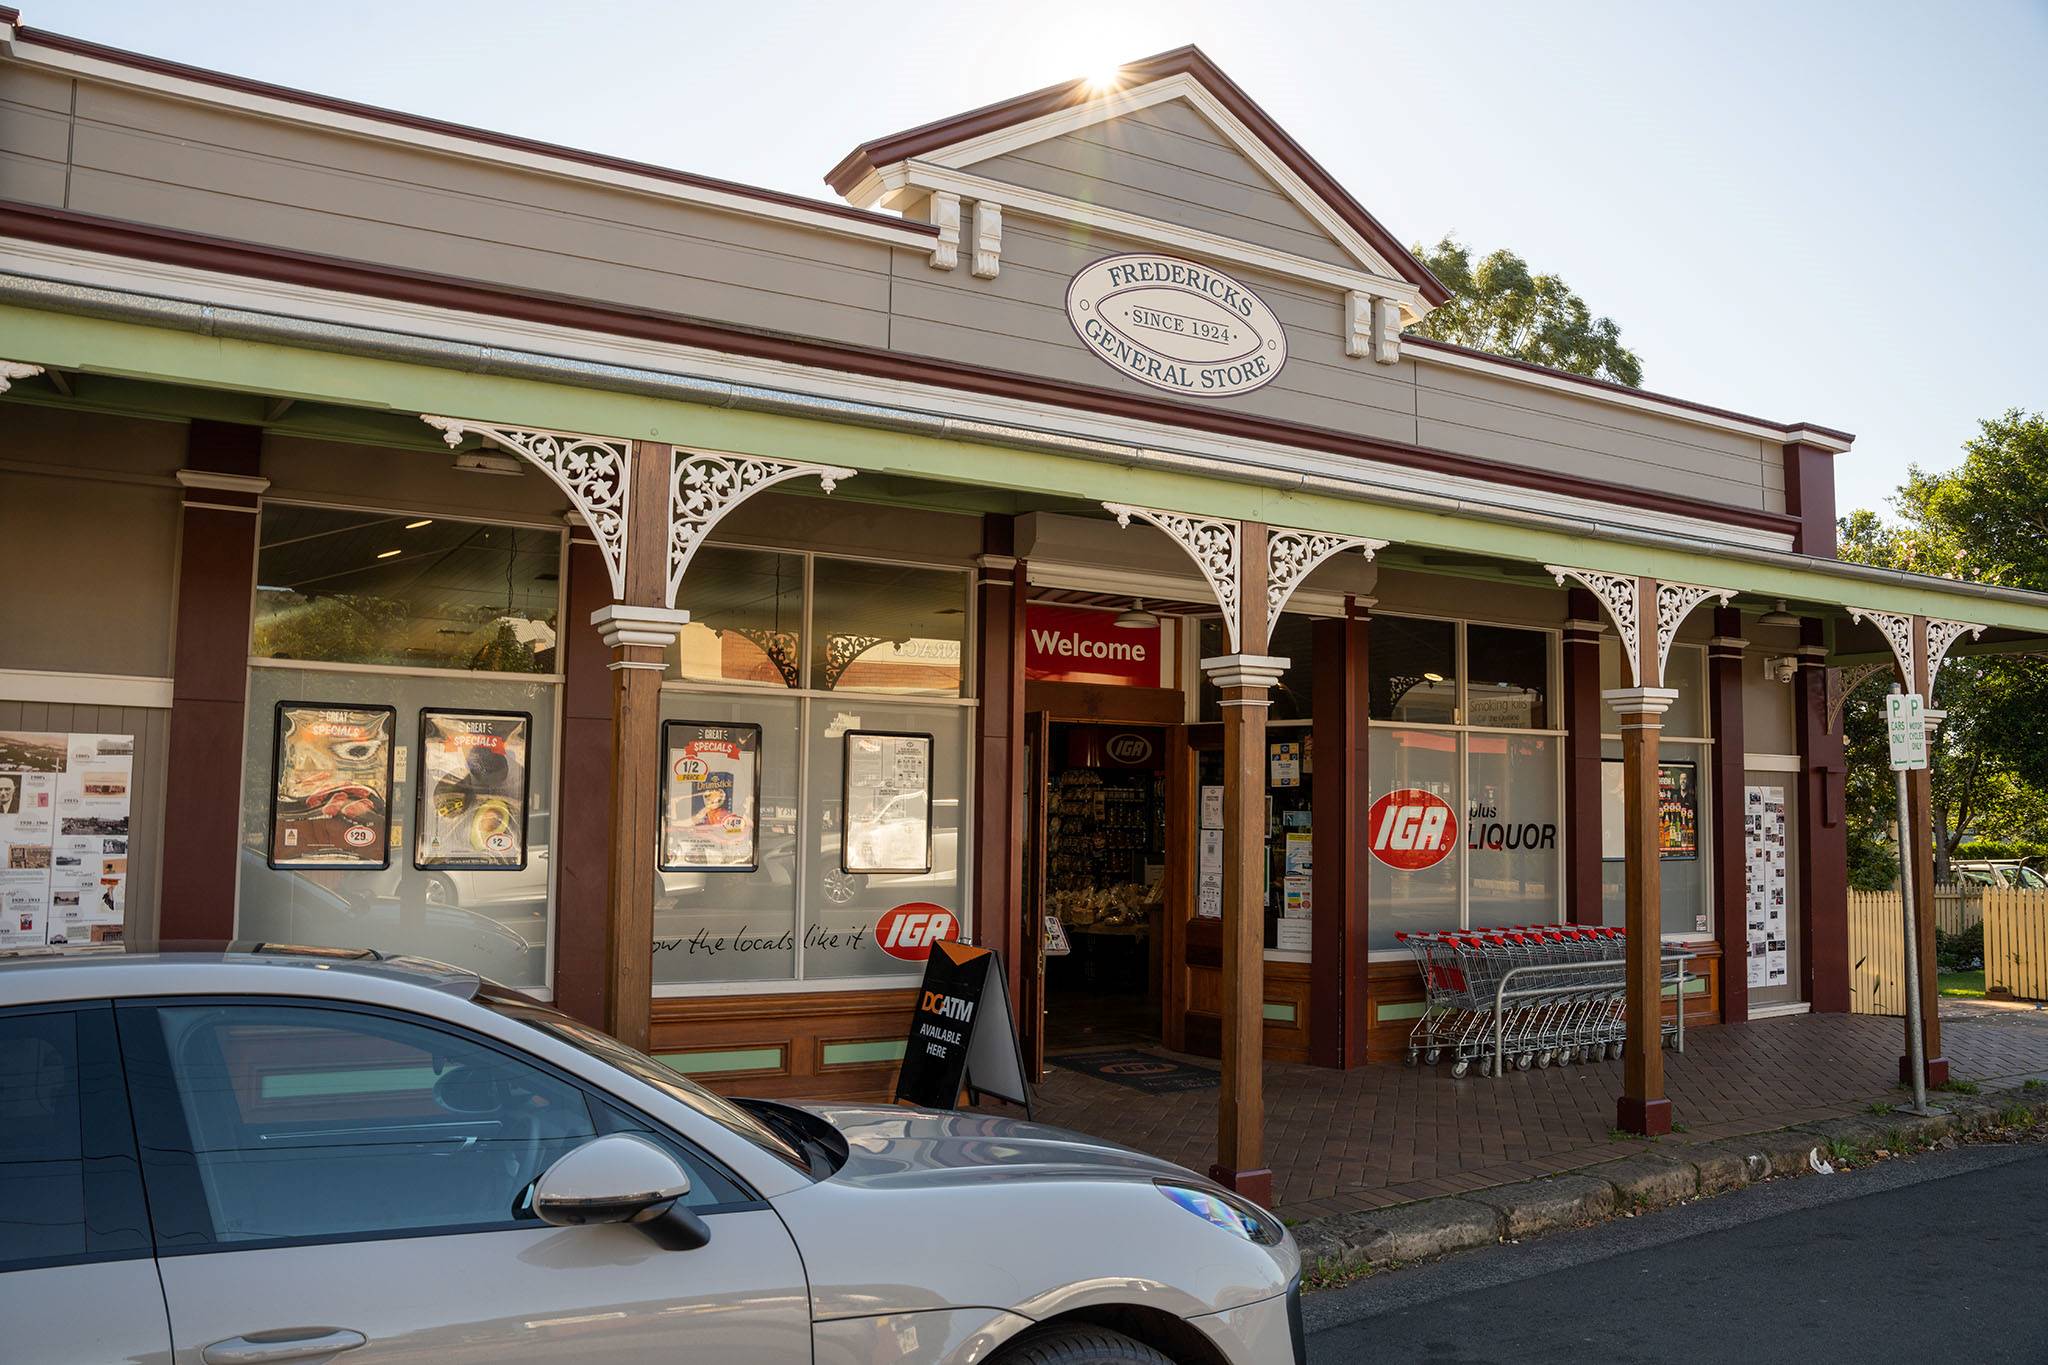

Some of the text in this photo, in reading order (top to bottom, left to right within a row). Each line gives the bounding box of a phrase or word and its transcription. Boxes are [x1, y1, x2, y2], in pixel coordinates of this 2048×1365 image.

[1108, 262, 1253, 317] FREDERICKS
[1132, 309, 1230, 341] SINCE 1924
[1084, 318, 1270, 389] GENERAL STORE
[1031, 629, 1146, 661] Welcome
[326, 711, 348, 722] GREAT
[1892, 700, 1900, 717] P
[1911, 700, 1918, 716] P
[313, 725, 360, 737] SPECIALS
[466, 722, 487, 733] GREAT
[704, 729, 723, 739] GREAT
[1891, 721, 1905, 730] CARS
[454, 735, 498, 747] SPECIALS
[694, 741, 733, 753] SPECIALS
[1892, 734, 1905, 743] ONLY
[1912, 742, 1923, 750] ONLY
[1115, 740, 1145, 757] IGA
[682, 761, 699, 773] 1/2
[1469, 802, 1497, 820] plus
[1374, 806, 1448, 851] IGA
[1469, 823, 1556, 851] LIQUOR
[885, 914, 952, 948] IGA
[689, 928, 726, 956] the
[733, 925, 794, 952] locals
[803, 924, 840, 950] like
[846, 924, 867, 950] it
[920, 1023, 962, 1045] AVAILABLE
[926, 1042, 948, 1059] HERE
